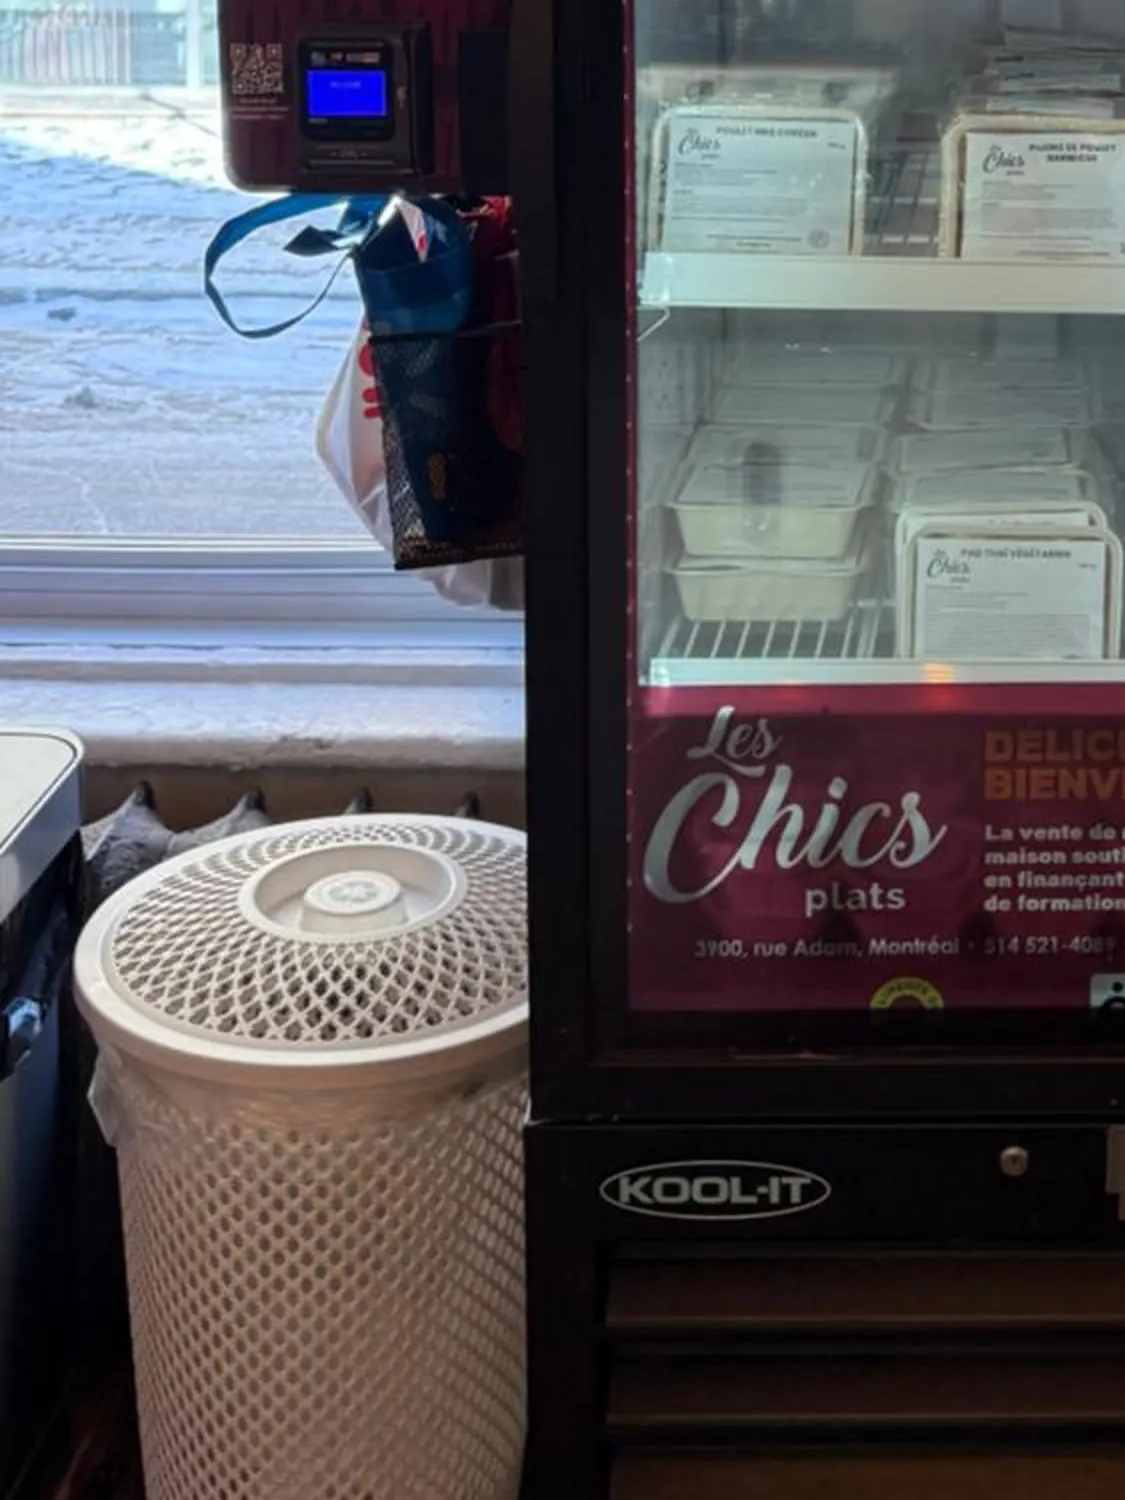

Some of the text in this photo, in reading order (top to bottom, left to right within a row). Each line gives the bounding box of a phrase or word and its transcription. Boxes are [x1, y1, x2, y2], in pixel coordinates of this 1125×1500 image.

[687, 705, 783, 778] Les
[643, 764, 948, 903] Chics
[985, 825, 1014, 841] La
[1019, 826, 1082, 841] vente
[1089, 824, 1116, 841] de
[984, 848, 1066, 864] maison
[984, 873, 1012, 888] en
[1017, 871, 1123, 892] finançant
[805, 883, 906, 918] plats
[984, 895, 1011, 912] de
[753, 942, 787, 956] rue
[868, 938, 959, 955] Montréal
[984, 937, 1020, 954] 514
[619, 1176, 812, 1205] KOOL-IT
